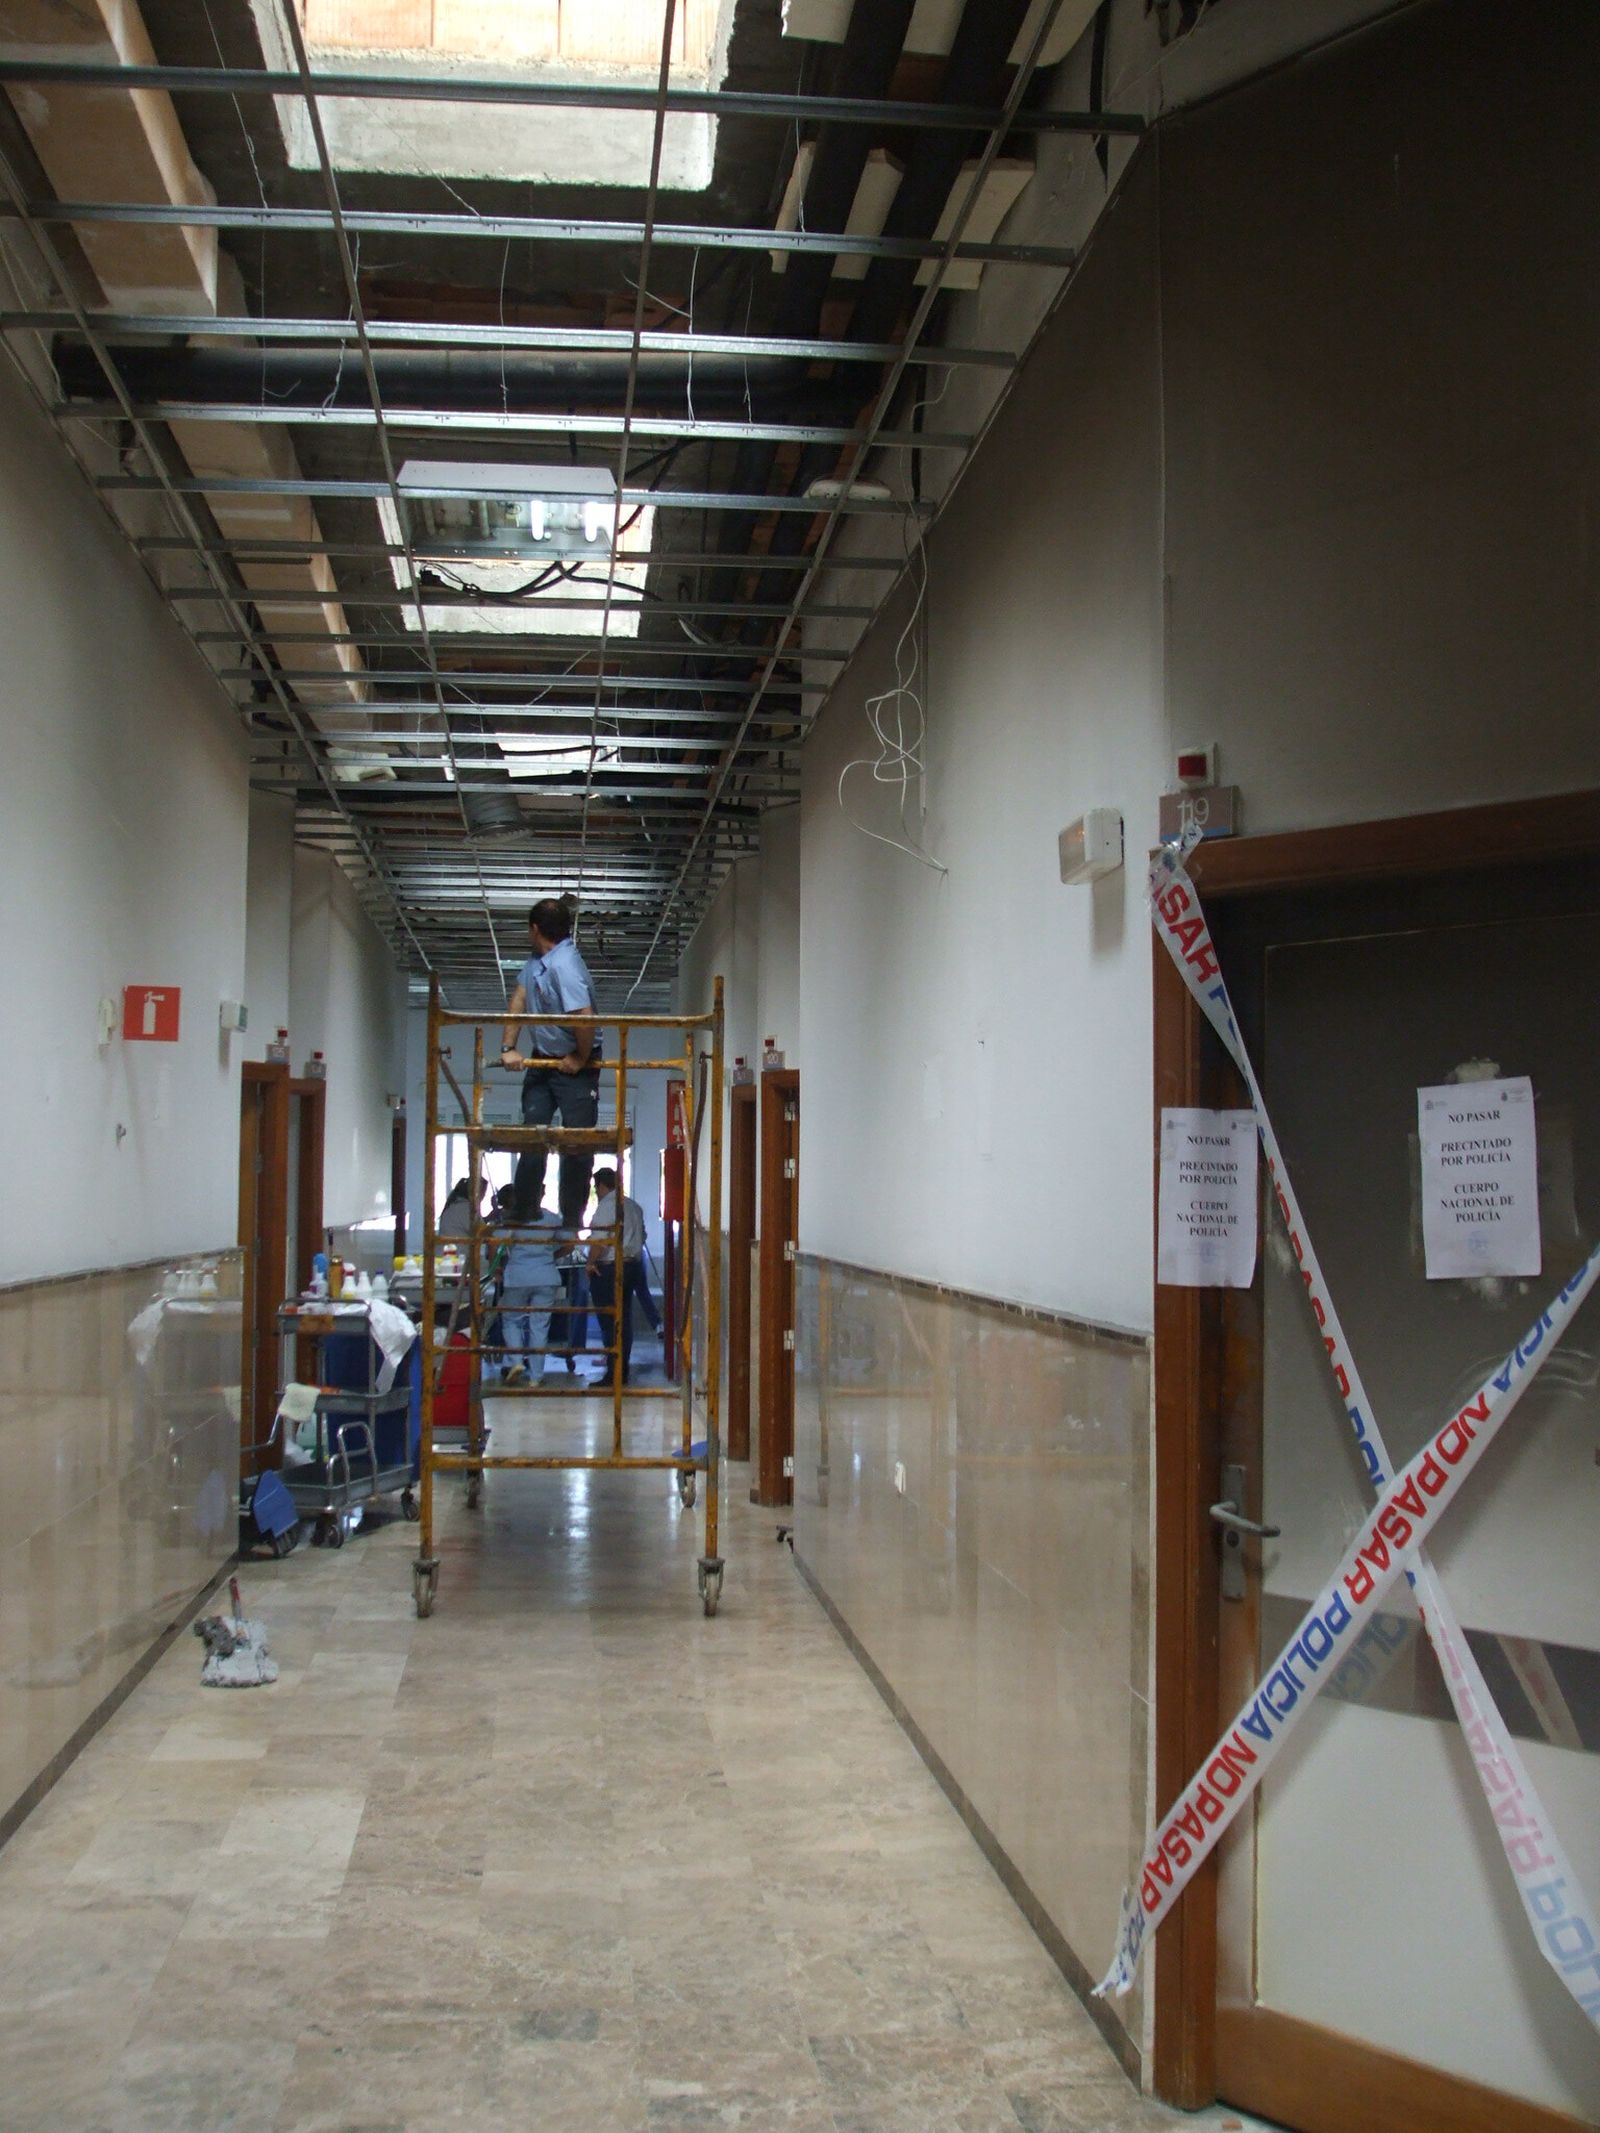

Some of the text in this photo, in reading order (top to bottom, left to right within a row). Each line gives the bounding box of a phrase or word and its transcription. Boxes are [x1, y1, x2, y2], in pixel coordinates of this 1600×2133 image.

[1447, 1110, 1501, 1124] NO PASAR
[1187, 1135, 1231, 1146] NO PASAR
[1441, 1137, 1512, 1153] PRECINTADO
[1179, 1161, 1238, 1172] PRECINTADO
[1441, 1155, 1463, 1167] POR
[1179, 1174, 1202, 1184] POR
[1454, 1182, 1499, 1194] CUERPO
[1190, 1201, 1228, 1211] CUERPO
[1440, 1196, 1515, 1210] NACIONAL DE
[1176, 1213, 1239, 1225] NACIONAL DE
[1343, 1451, 1449, 1606] PASAR
[1240, 1590, 1353, 1742] POLICIA
